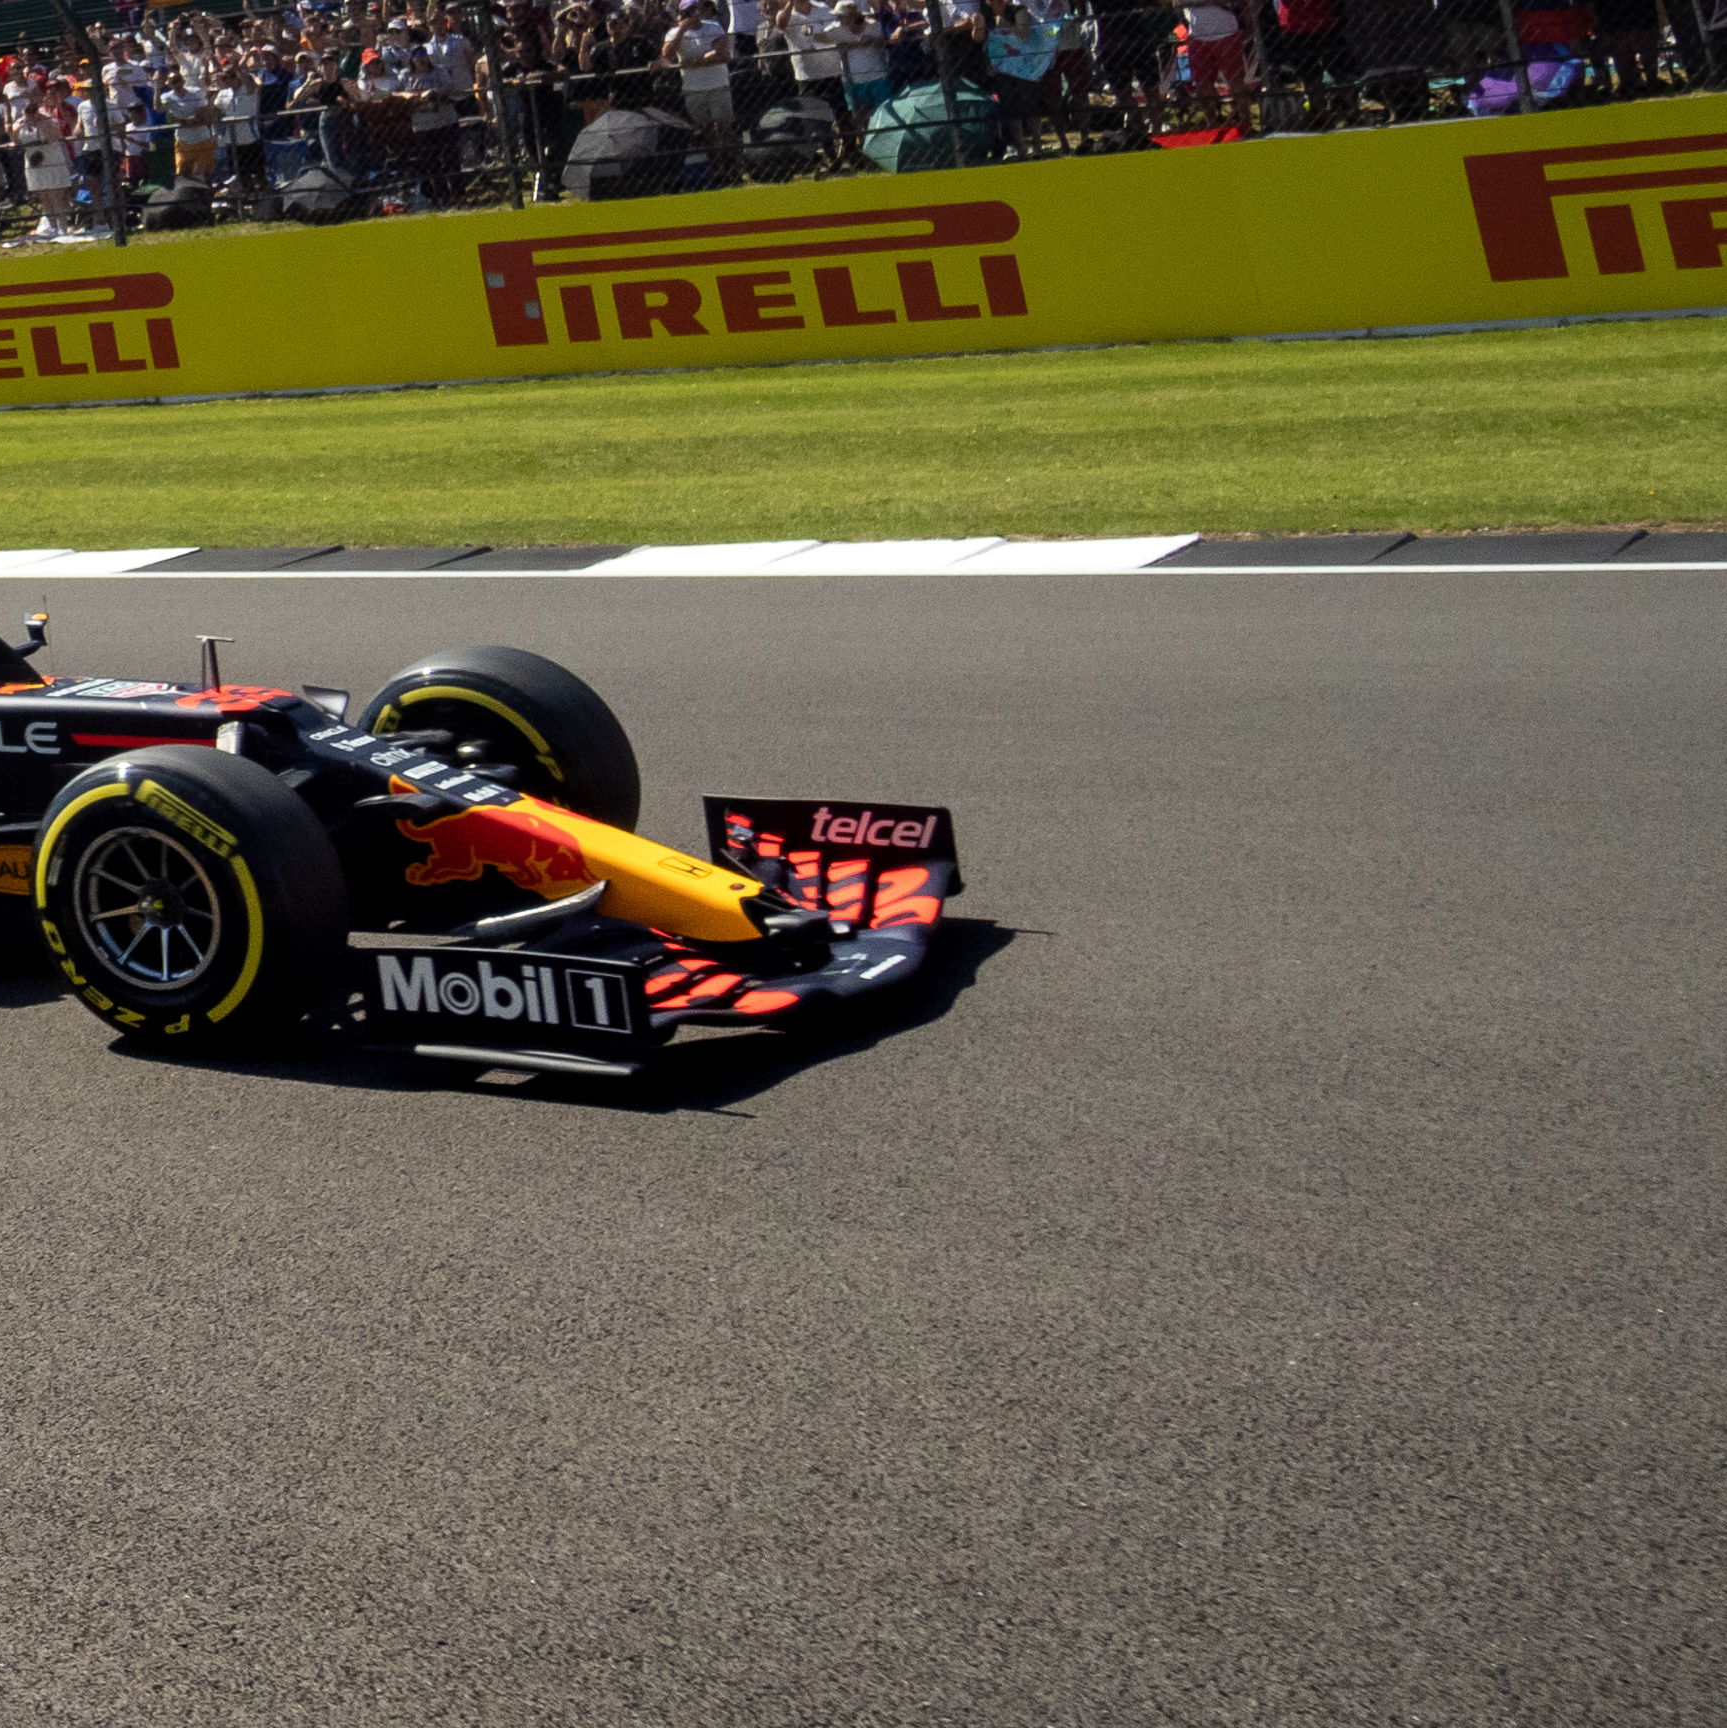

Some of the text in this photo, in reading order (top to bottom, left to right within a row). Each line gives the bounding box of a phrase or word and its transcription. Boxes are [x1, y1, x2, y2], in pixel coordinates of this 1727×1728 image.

[478, 199, 1028, 348] PIRELLI
[135, 779, 238, 861] PIRELLI
[810, 806, 938, 849] telcel
[377, 955, 611, 1027] Mobil 1
